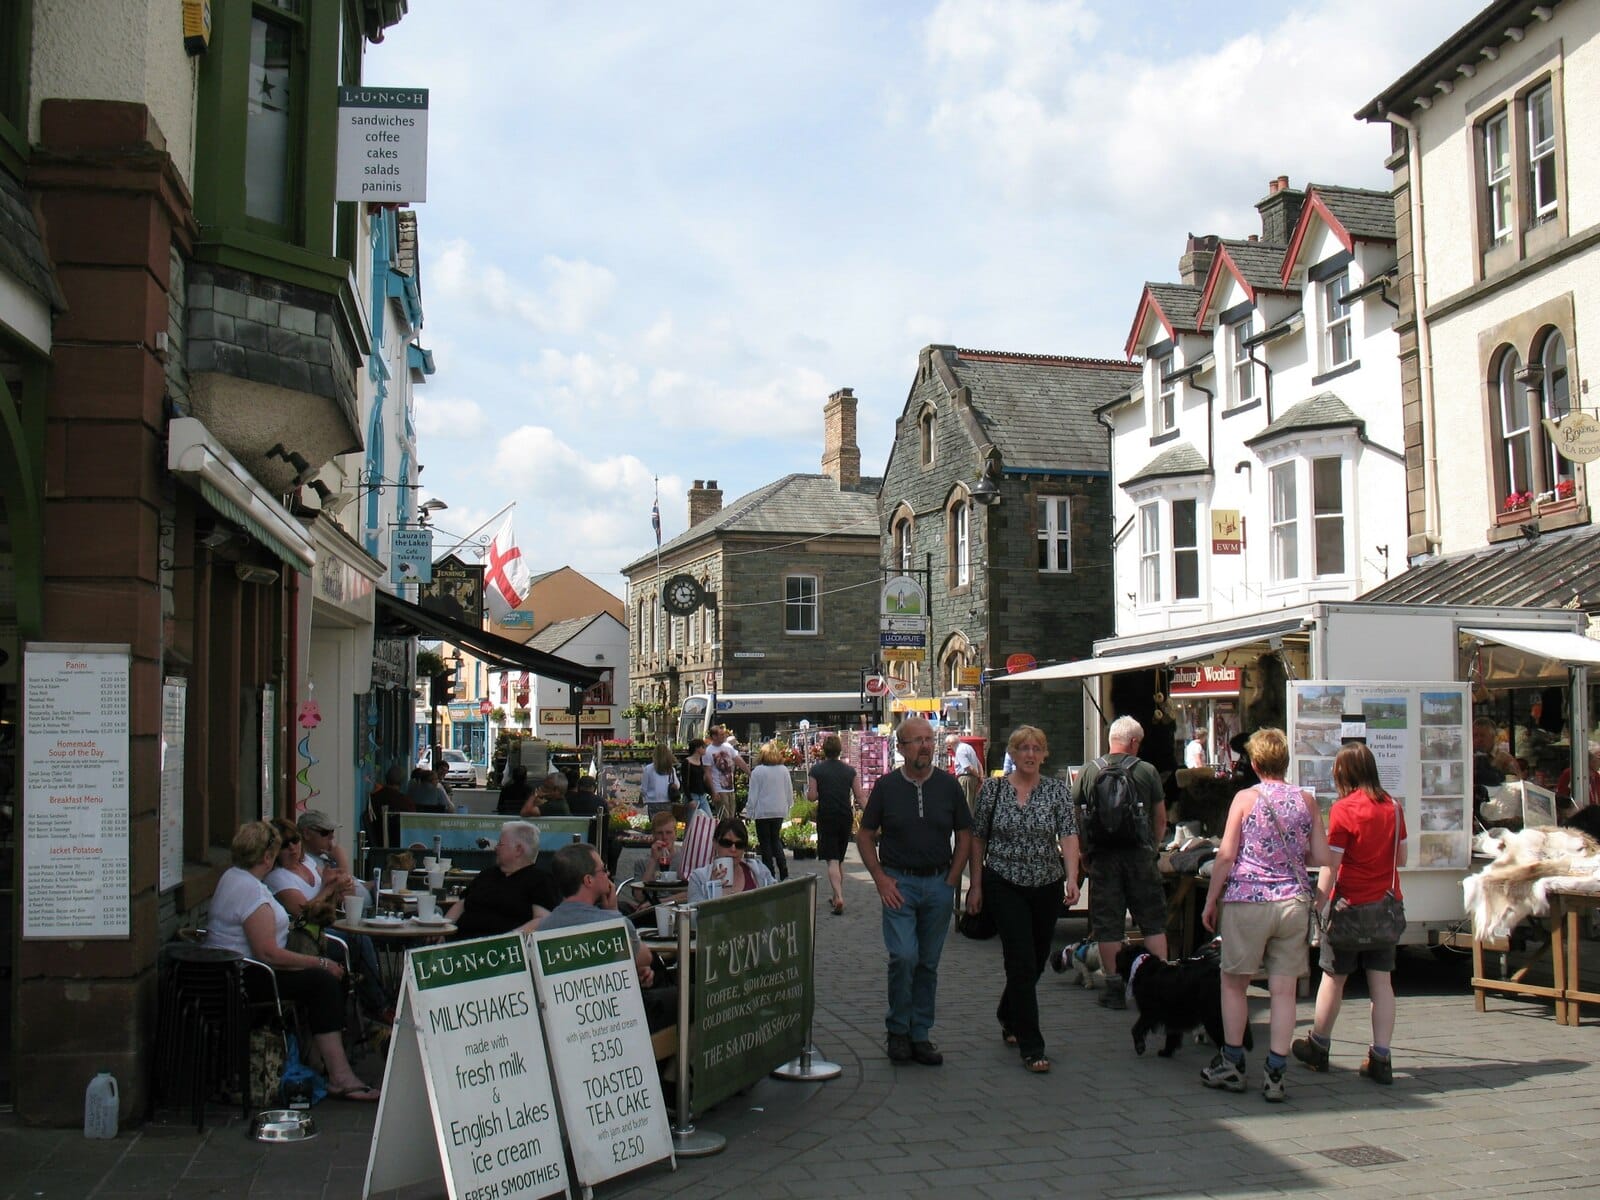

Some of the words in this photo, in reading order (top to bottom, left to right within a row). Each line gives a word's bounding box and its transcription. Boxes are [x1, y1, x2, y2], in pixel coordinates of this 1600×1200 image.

[351, 114, 415, 126] sandwiches
[365, 131, 400, 142] coffee
[367, 148, 398, 158] cakes
[364, 164, 400, 175] salads
[362, 180, 402, 194] paninis
[66, 661, 87, 669] Panini
[1204, 666, 1236, 682] Woollen
[48, 750, 66, 758] Soup
[91, 748, 104, 758] Day
[57, 740, 96, 748] Homemade
[50, 796, 82, 804] Breakfast
[553, 969, 632, 1004] HOMEMADE
[430, 991, 528, 1035] MILKSHAKES
[576, 996, 620, 1025] SCONE
[592, 1026, 609, 1038] butter
[610, 1022, 621, 1032] and
[621, 1018, 638, 1030] cream
[464, 1038, 490, 1057] made
[492, 1034, 510, 1050] with
[592, 1038, 623, 1064] £3.50
[703, 1044, 724, 1070] THE
[456, 1060, 496, 1090] fresh
[500, 1051, 527, 1078] milk
[583, 1066, 644, 1100] TOASTED
[492, 1087, 500, 1104] &
[586, 1104, 614, 1127] TEA
[616, 1088, 652, 1117] CAKE
[450, 1110, 504, 1148] English
[508, 1102, 550, 1130] Lakes
[622, 1122, 632, 1133] and
[632, 1117, 648, 1128] butter
[471, 1150, 494, 1176] ice
[497, 1136, 542, 1169] cream
[612, 1135, 644, 1164] £2.50
[465, 1180, 500, 1200] FRESH
[502, 1162, 560, 1196] SMOOTHIES
